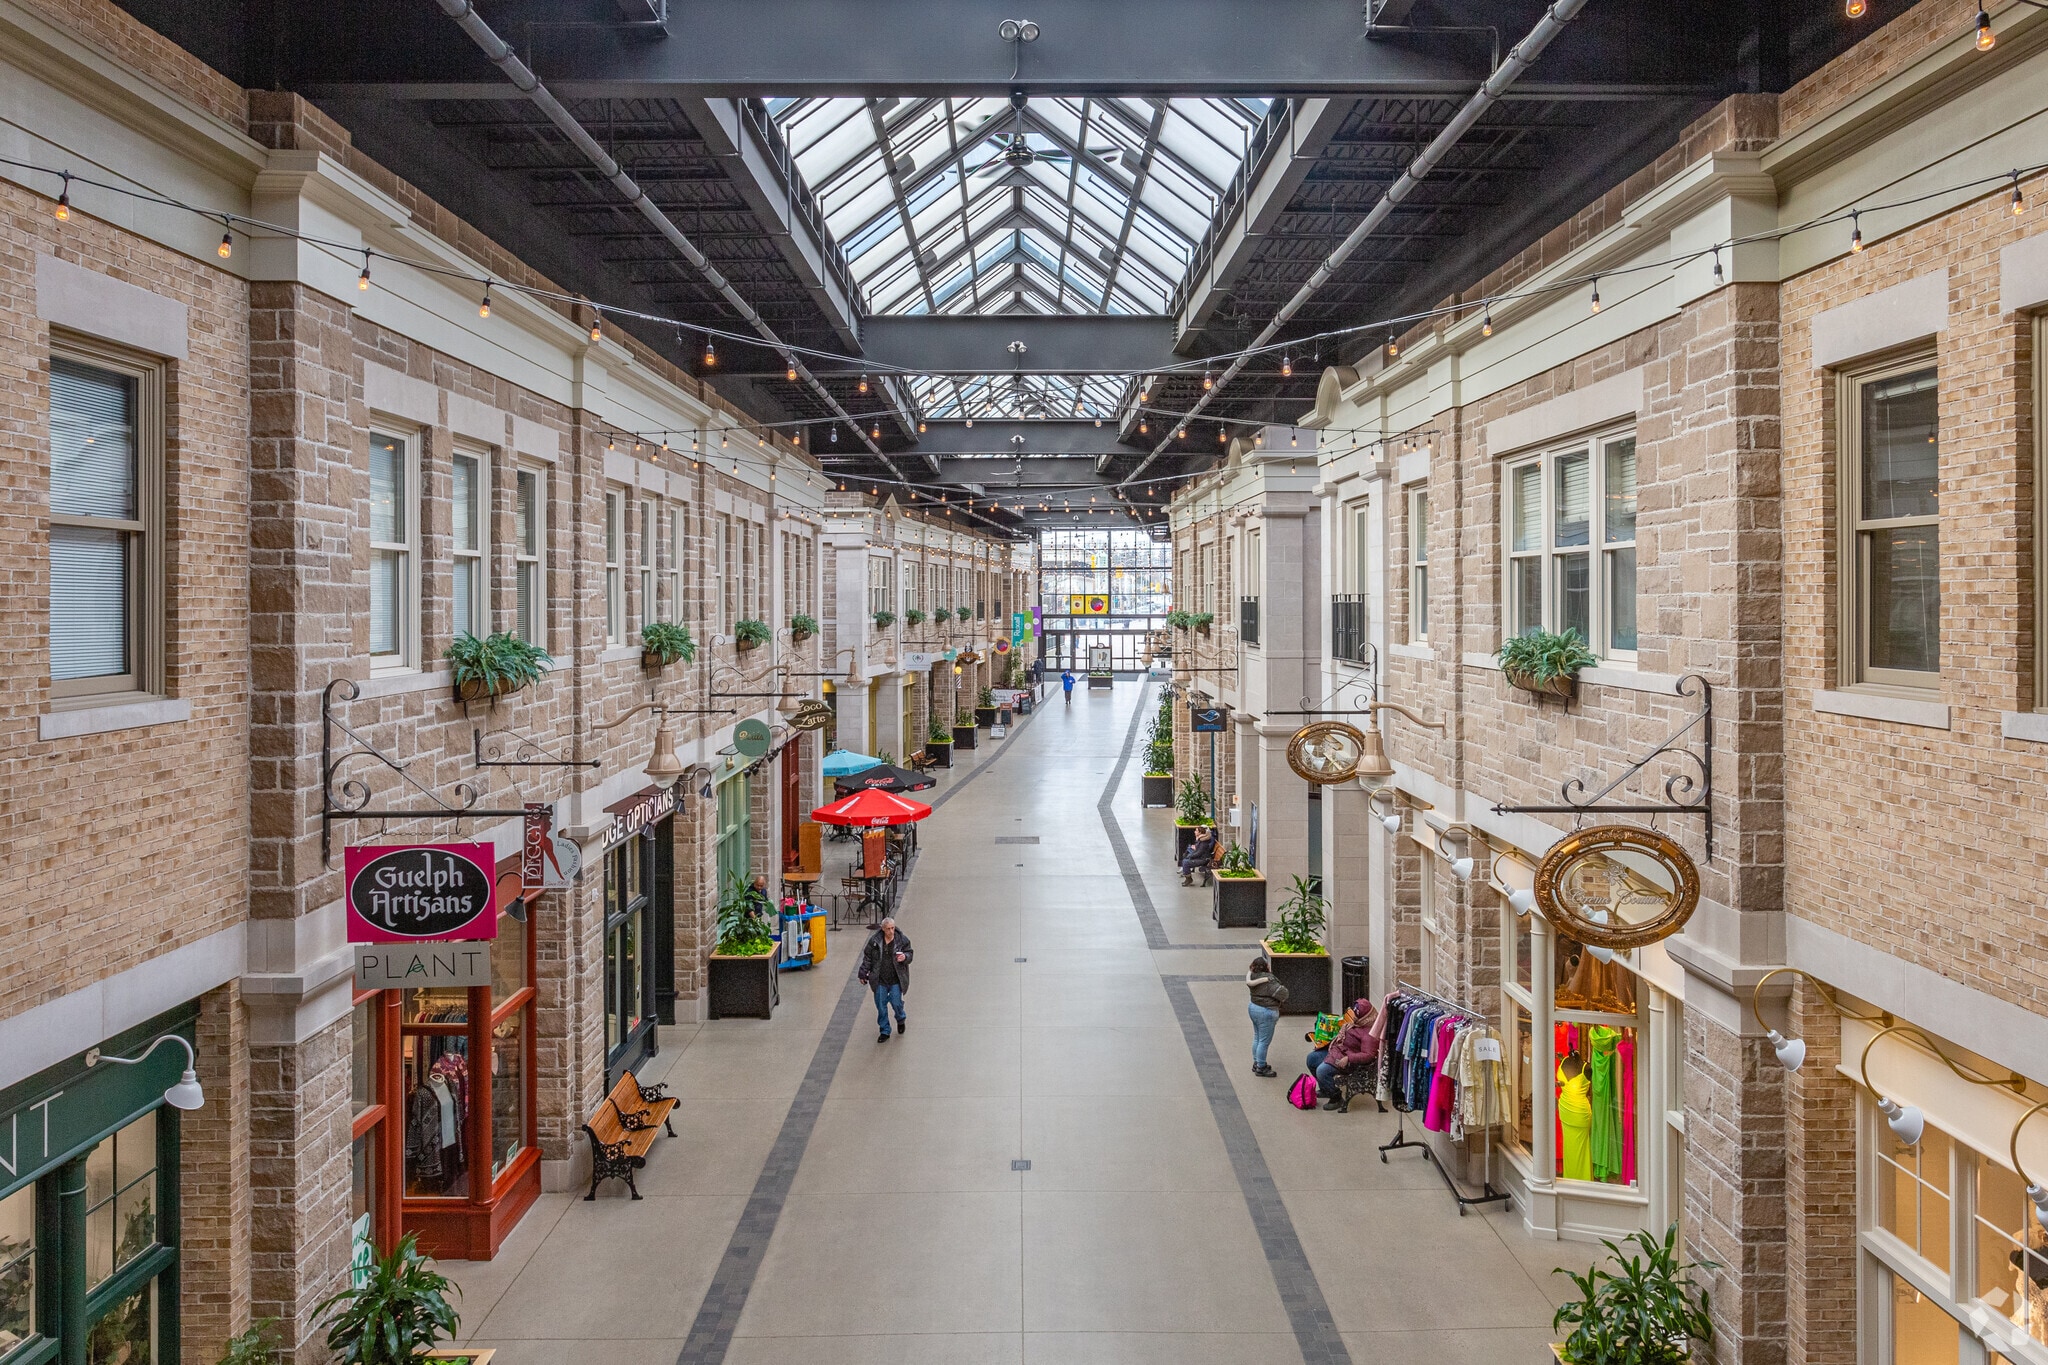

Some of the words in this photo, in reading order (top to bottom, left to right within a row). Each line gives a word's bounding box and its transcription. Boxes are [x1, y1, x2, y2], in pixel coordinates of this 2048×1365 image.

[795, 714, 826, 729] Latte
[626, 786, 675, 833] OPTICIANS
[374, 852, 465, 895] Guelph
[368, 888, 473, 928] Artisans
[362, 951, 483, 980] PLANT
[1478, 1046, 1498, 1054] SALE
